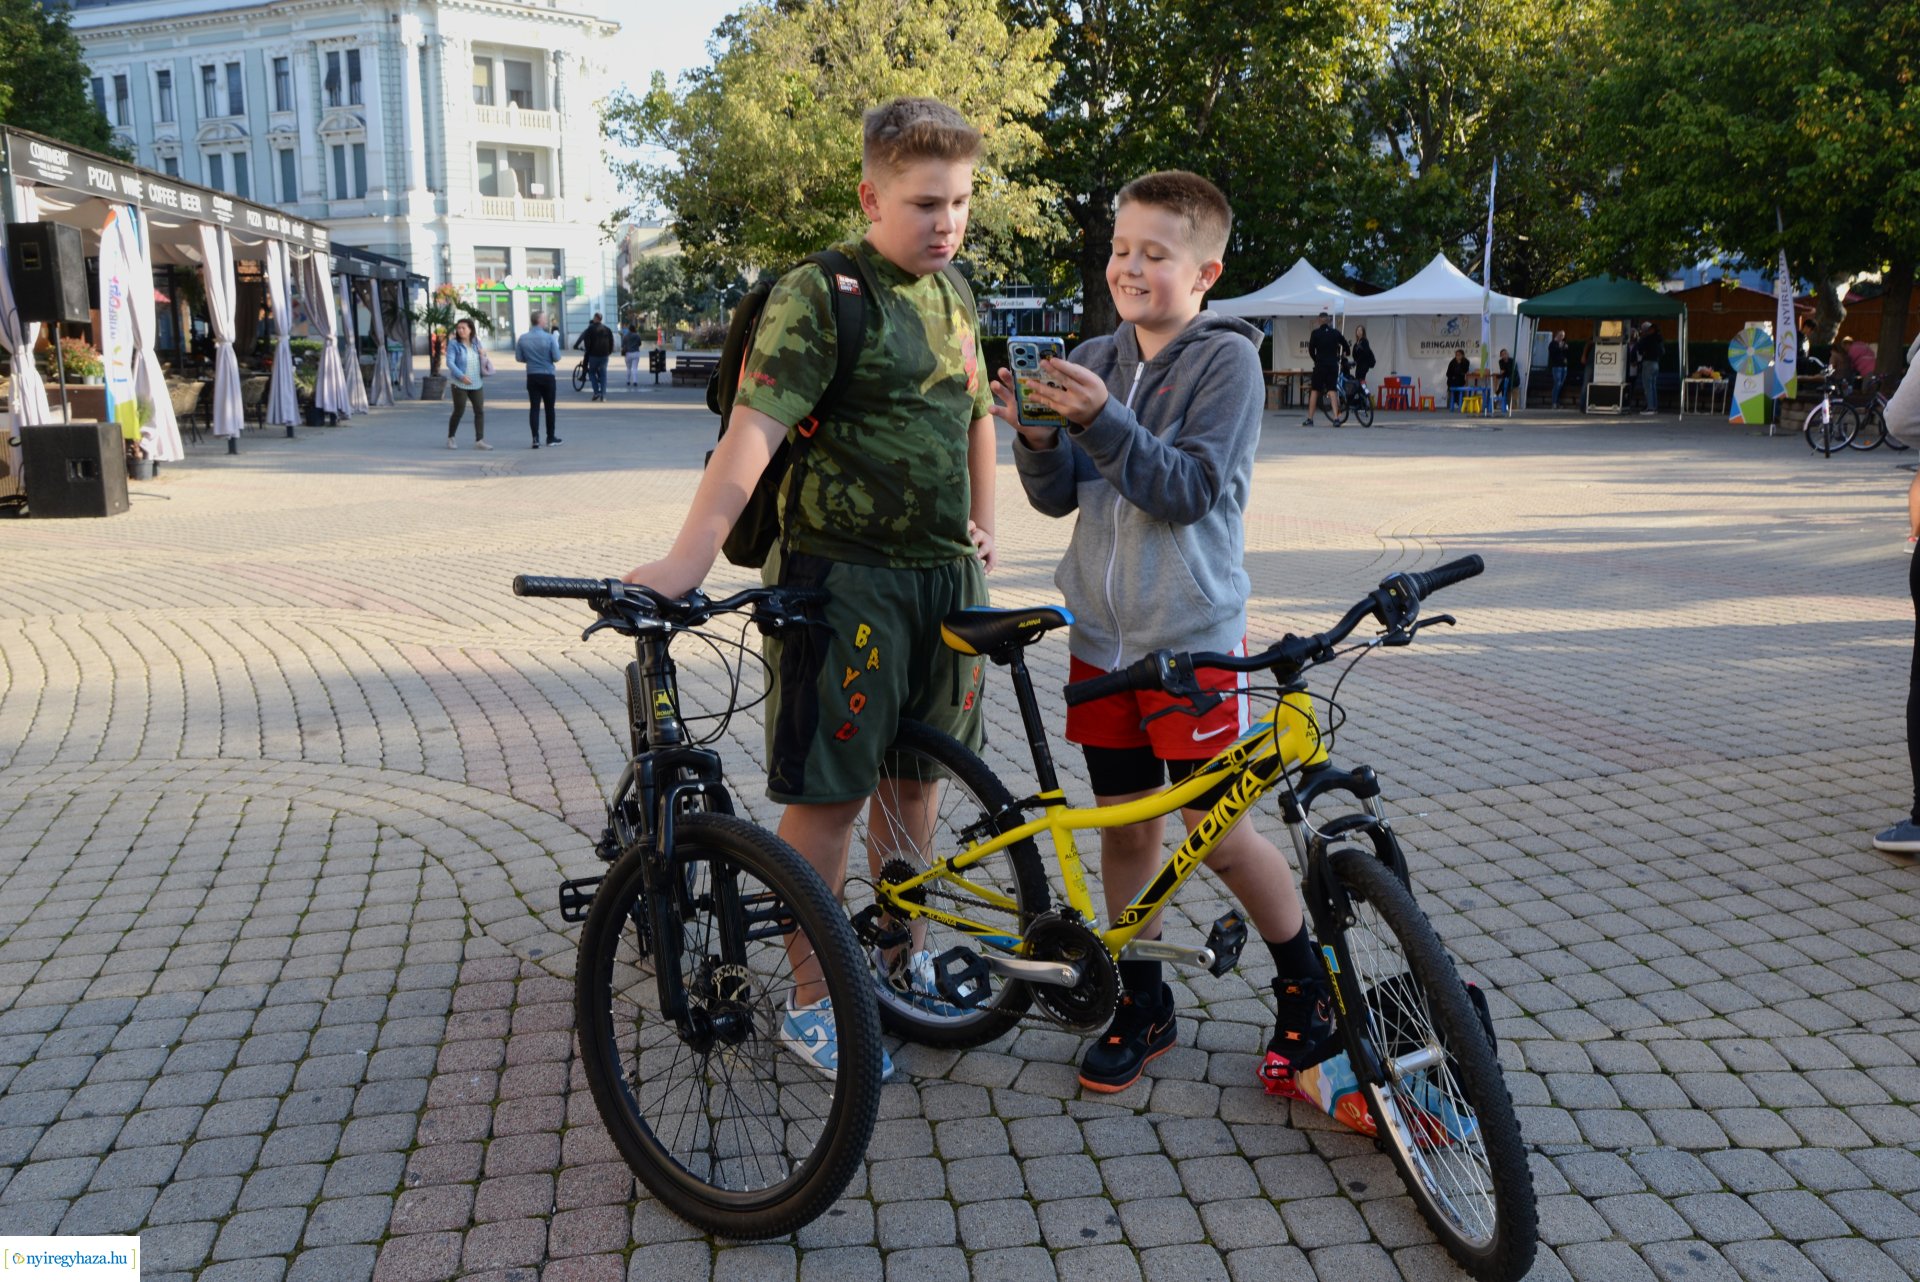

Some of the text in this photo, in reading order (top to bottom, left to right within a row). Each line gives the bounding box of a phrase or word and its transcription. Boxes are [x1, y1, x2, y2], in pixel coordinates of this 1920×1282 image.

[87, 166, 117, 192] PIZZA
[120, 175, 144, 200] WINE
[148, 183, 178, 208] COFFEE
[180, 192, 202, 213] BEER
[1174, 768, 1266, 880] ALPINA
[926, 913, 957, 928] ALPINA
[1117, 910, 1138, 925] 30
